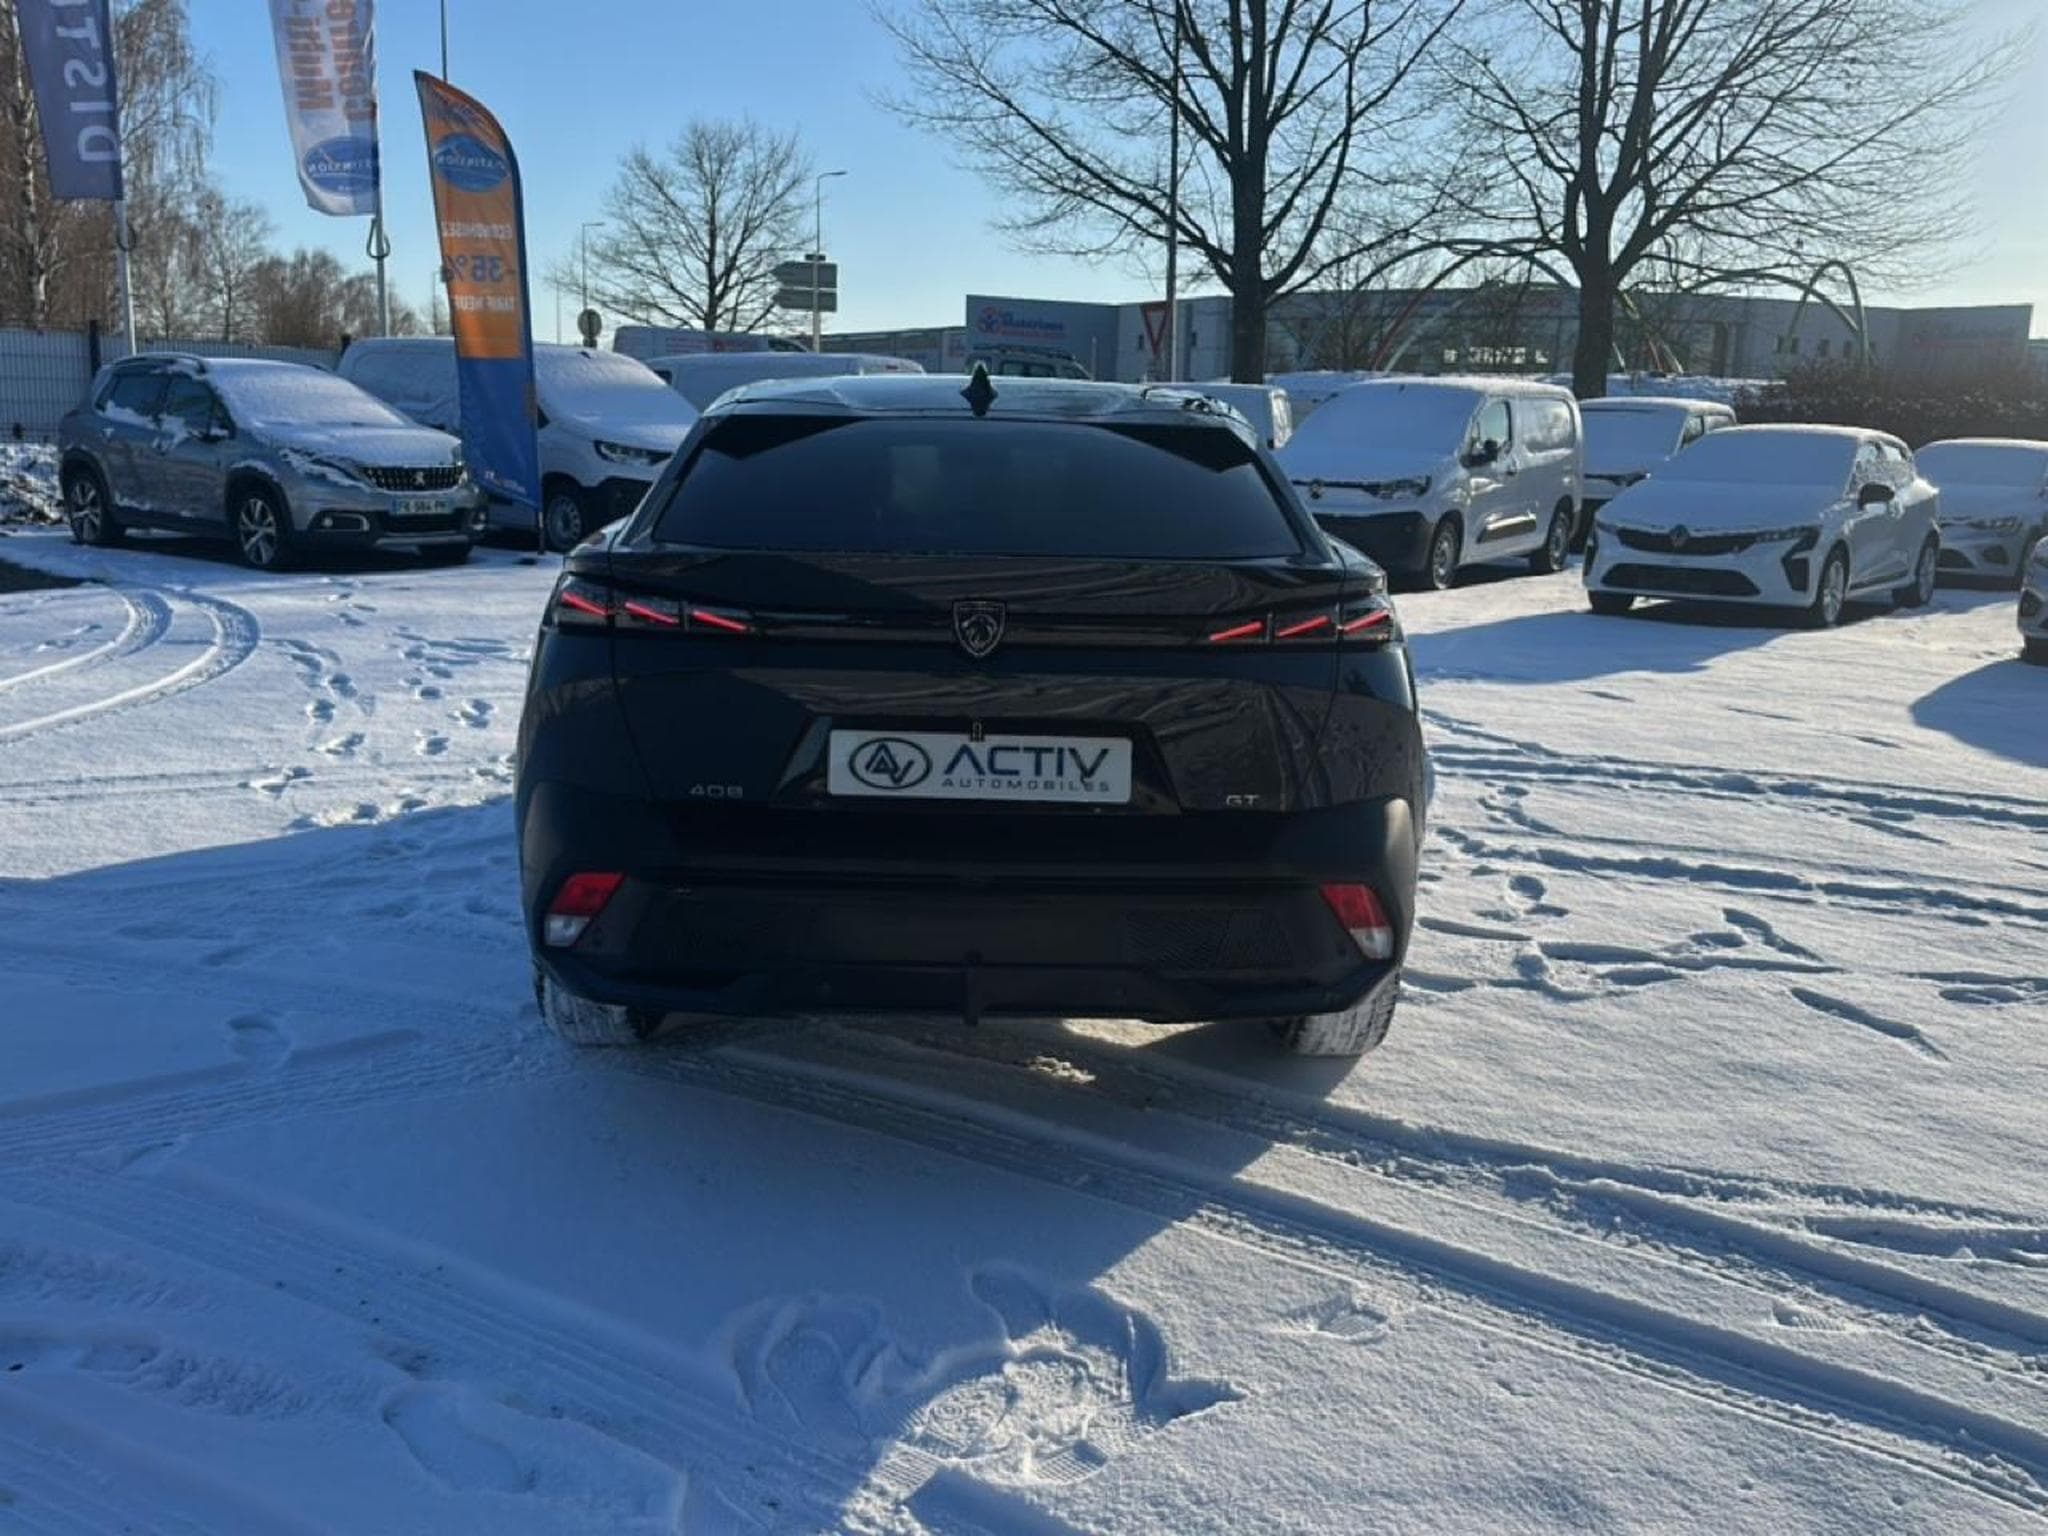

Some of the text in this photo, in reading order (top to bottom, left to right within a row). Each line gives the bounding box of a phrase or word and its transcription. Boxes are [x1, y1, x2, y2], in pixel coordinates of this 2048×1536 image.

[944, 743, 1110, 779] ACTIV
[688, 784, 743, 799] 408
[942, 778, 1110, 793] AUTOMOBILES
[1225, 794, 1260, 808] GT
